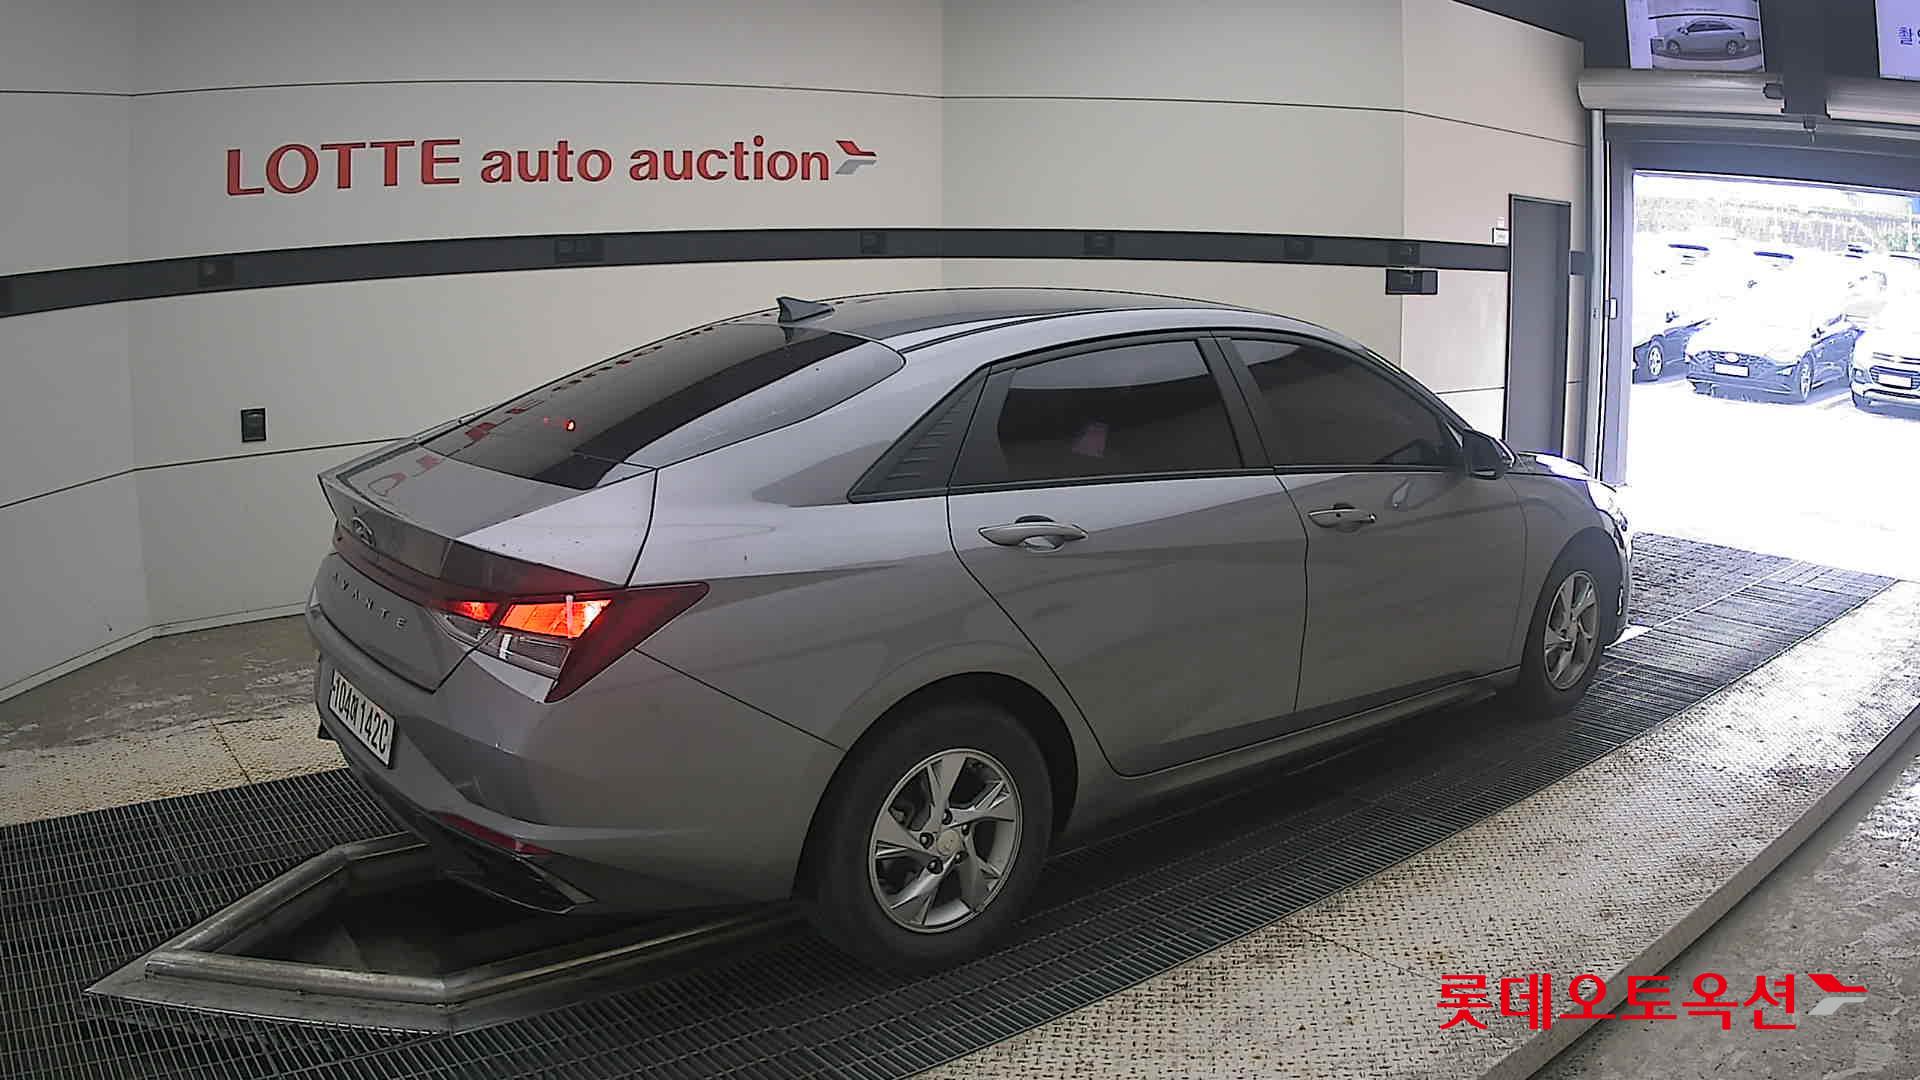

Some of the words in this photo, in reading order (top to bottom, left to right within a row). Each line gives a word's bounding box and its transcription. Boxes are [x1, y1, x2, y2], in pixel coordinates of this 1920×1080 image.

[226, 139, 461, 196] LOTTE
[481, 141, 613, 182] auto
[629, 135, 830, 181] auction
[333, 573, 408, 629] AVANTE
